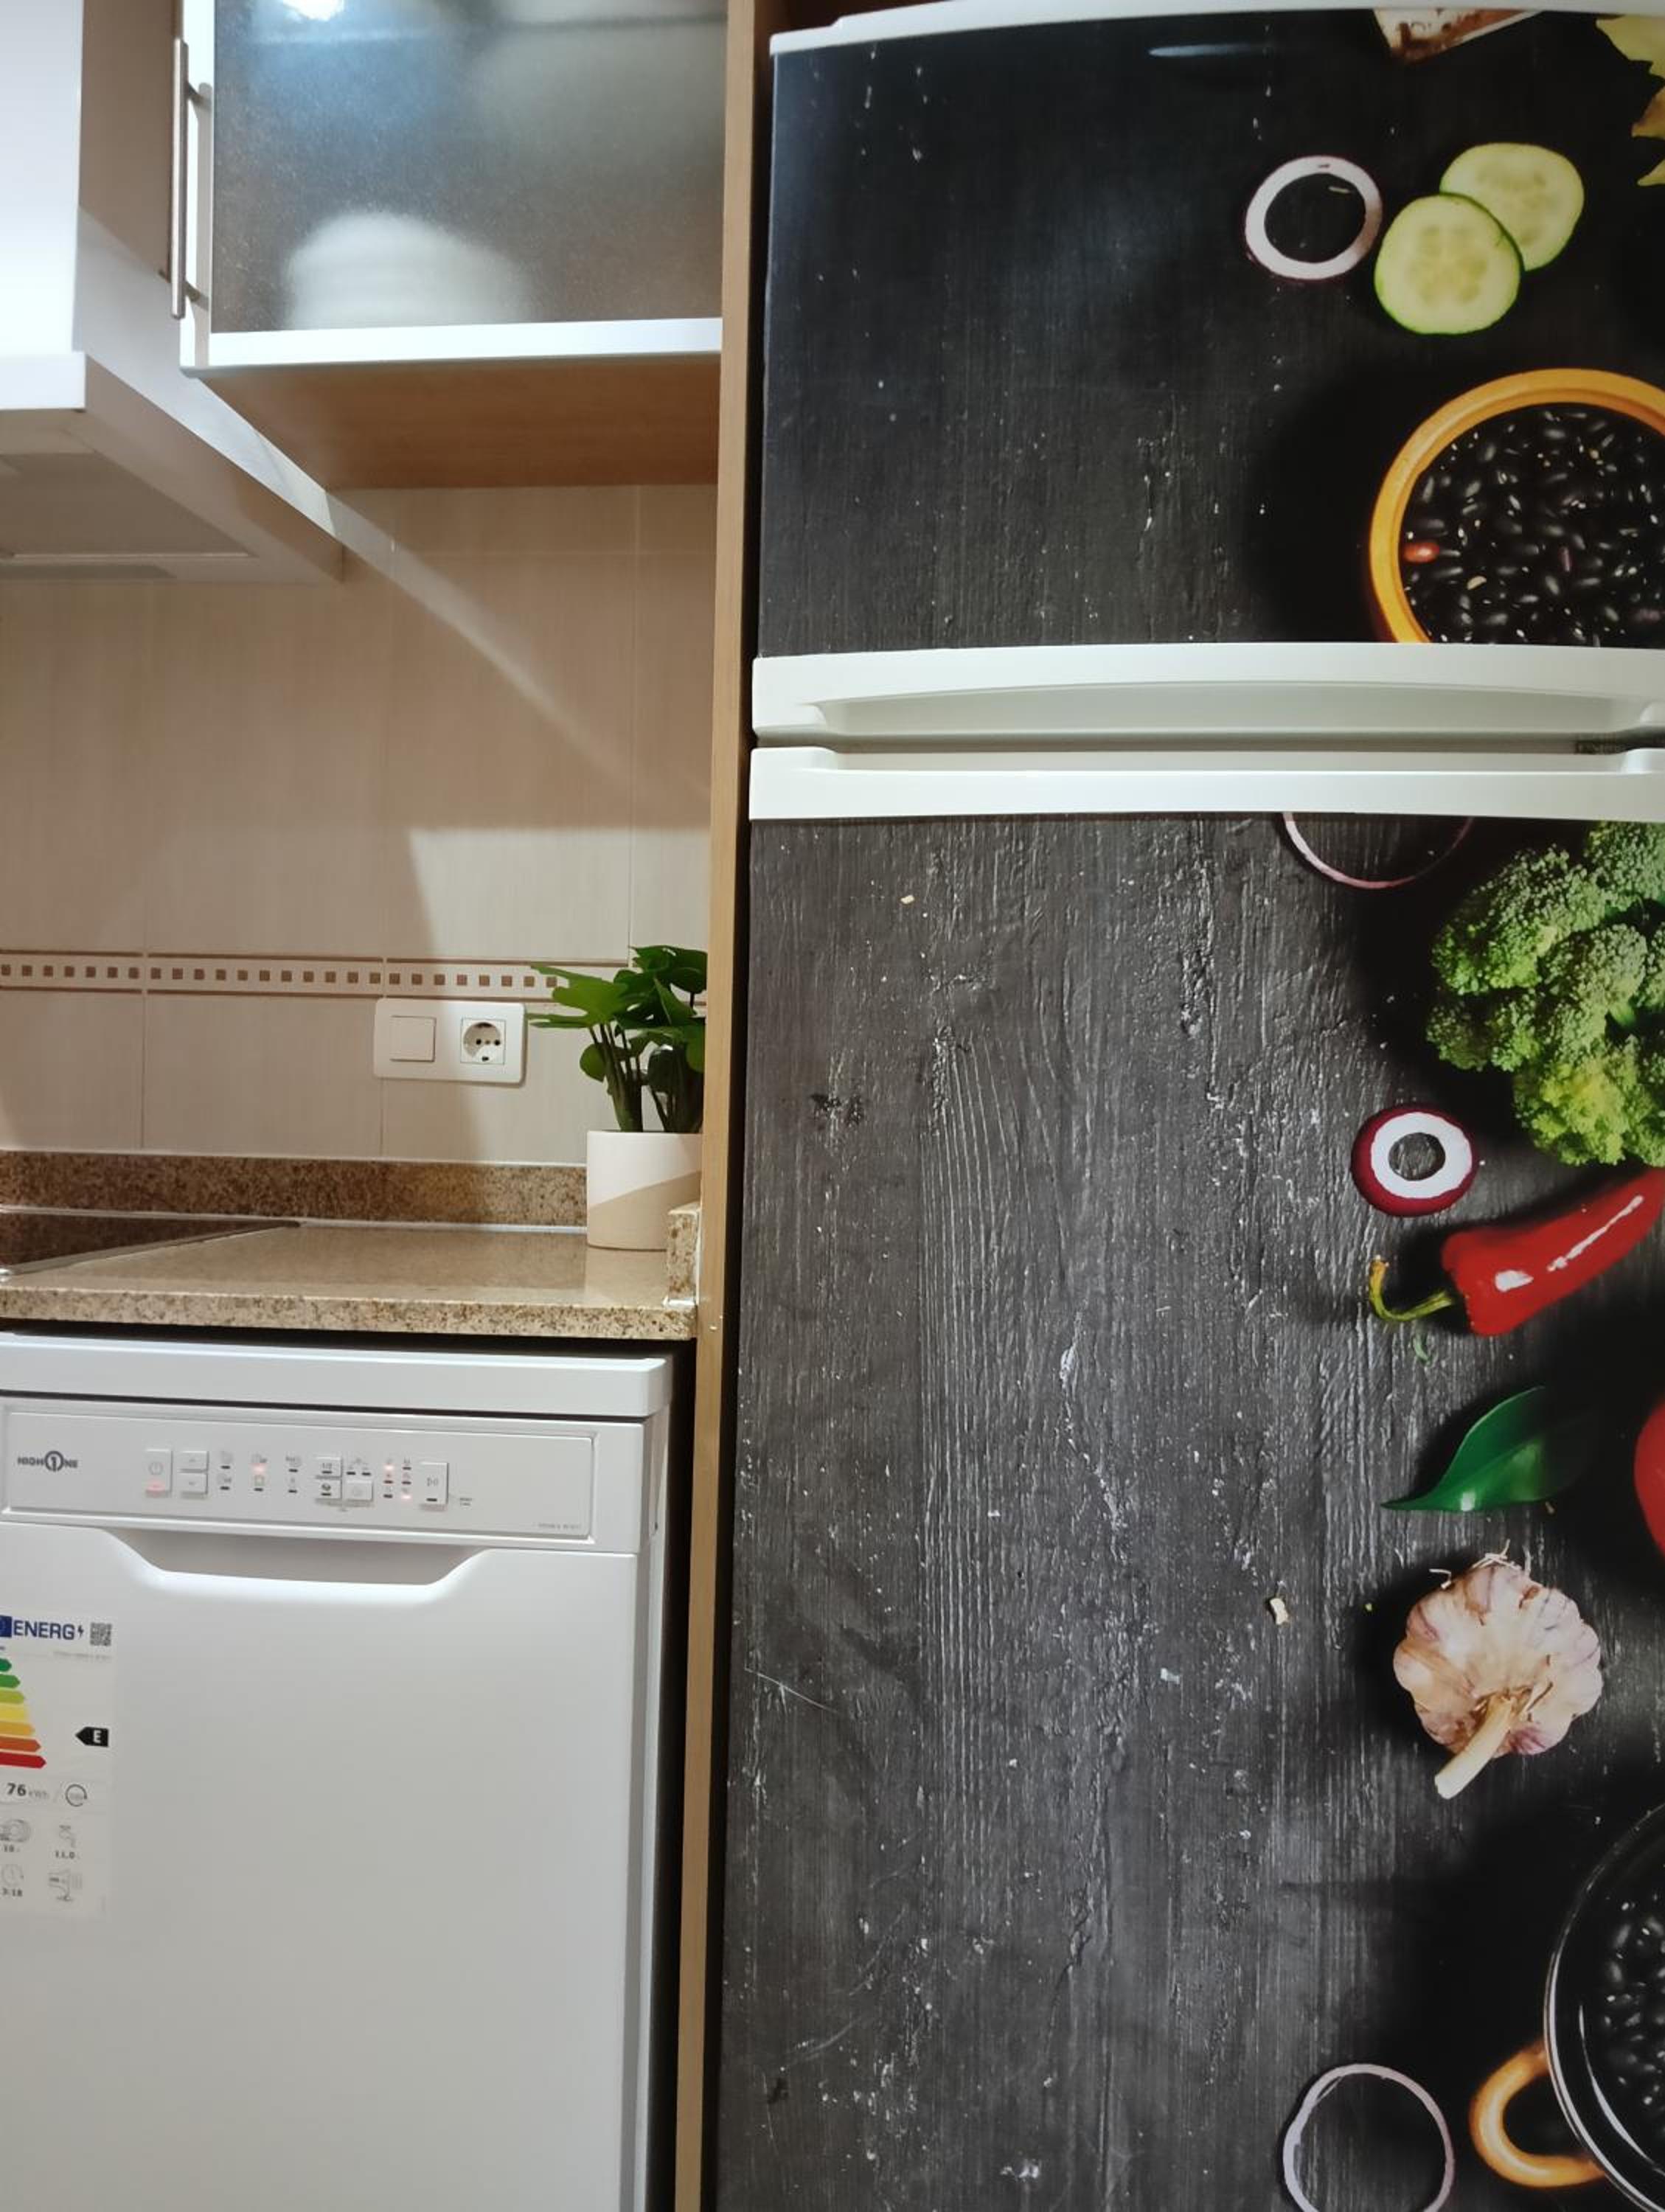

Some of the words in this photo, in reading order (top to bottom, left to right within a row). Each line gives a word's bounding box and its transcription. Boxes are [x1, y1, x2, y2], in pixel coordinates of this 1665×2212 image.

[13, 1620, 75, 1641] ENERG
[94, 1730, 102, 1744] E
[7, 1782, 27, 1797] 76
